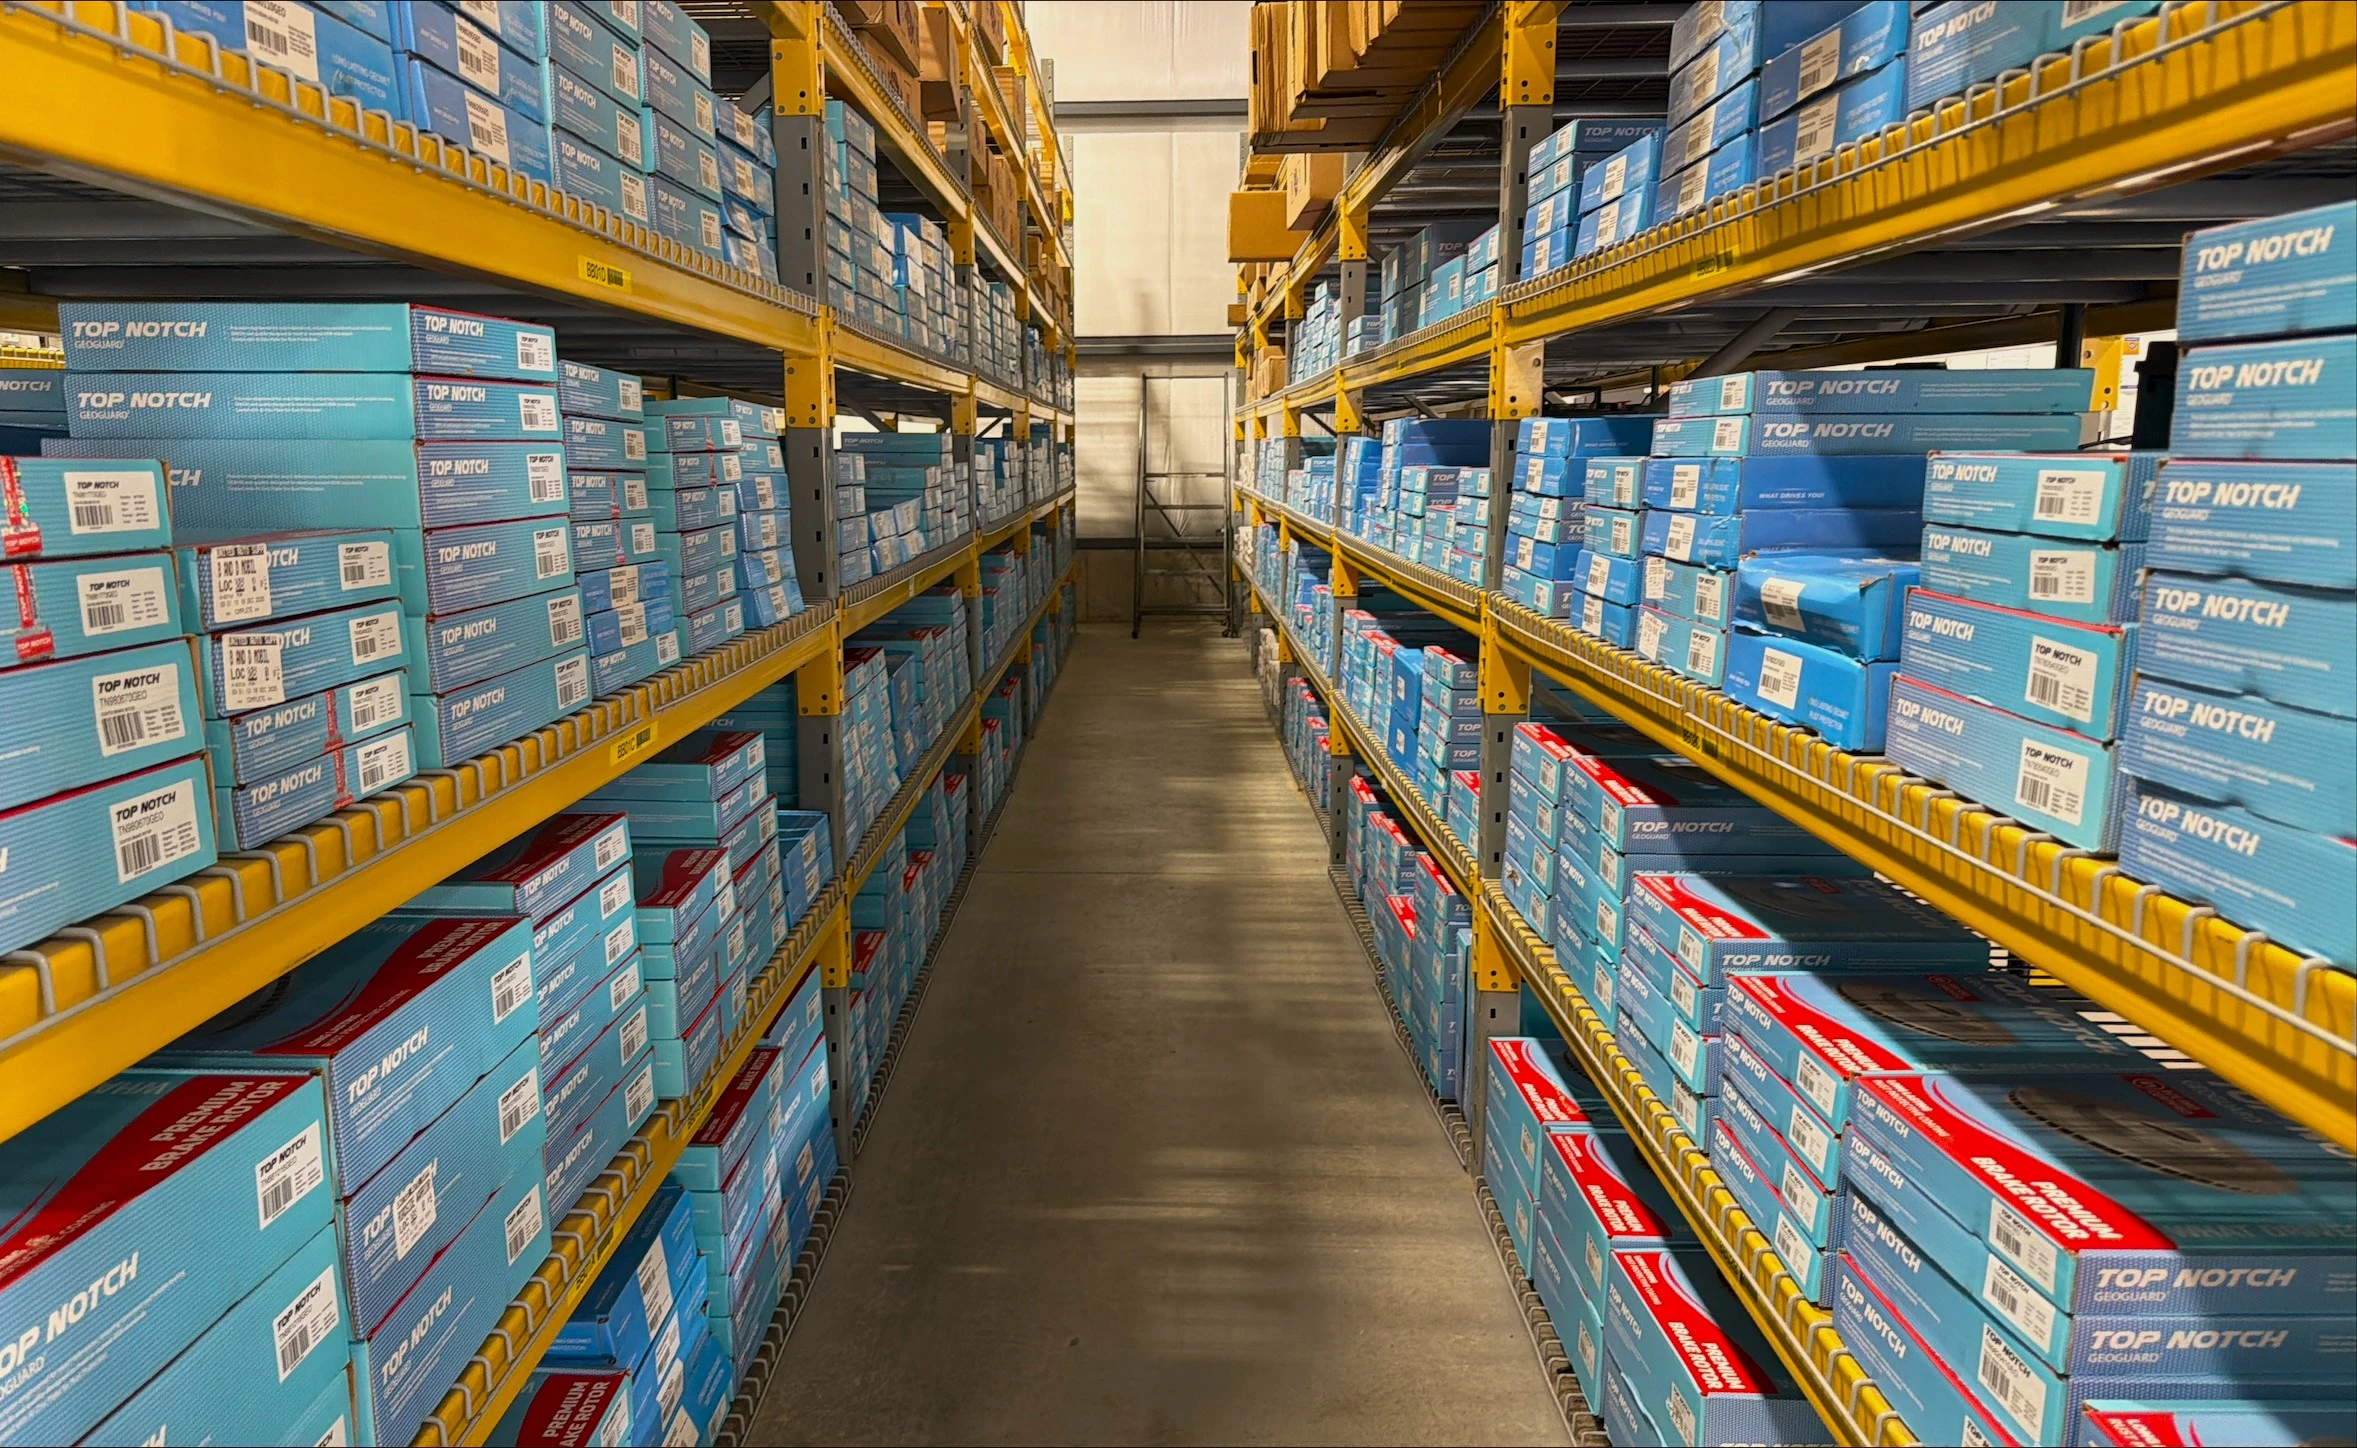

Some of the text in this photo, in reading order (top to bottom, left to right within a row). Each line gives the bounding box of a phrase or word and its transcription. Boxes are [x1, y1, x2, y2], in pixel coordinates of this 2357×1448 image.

[554, 4, 592, 42] TOP NOTCH
[1917, 2, 1995, 51] TOP NOTCH
[559, 75, 573, 91] TOP
[574, 84, 596, 109] NOTCH
[560, 141, 600, 172] TOP NOTCH
[2196, 225, 2334, 273] TOP NOTCH
[72, 322, 207, 338] TOP NOTCH
[425, 315, 483, 337] TOP NOTCH
[74, 340, 124, 349] GEOGUARD
[0, 380, 51, 392] NOTCH
[1766, 379, 1901, 395] TOP NOTCH
[2189, 358, 2324, 390] TOP NOTCH
[78, 392, 212, 408] TOP NOTCH
[428, 384, 485, 402] TOP NOTCH
[1766, 397, 1815, 405] GEOGUARD
[79, 410, 129, 420] GEOGUARD
[1762, 423, 1894, 438] TOP NOTCH
[1762, 440, 1809, 448] GEOGUARD
[430, 460, 489, 476] TOP NOTCH
[1433, 473, 1456, 481] TOP
[1932, 464, 1998, 483] TOP NOTCH
[2165, 481, 2301, 510] TOP NOTCH
[439, 541, 496, 564] TOP NOTCH
[1928, 534, 1992, 557] TOP NOTCH
[219, 580, 233, 592] LOC
[2155, 588, 2290, 628] TOP NOTCH
[441, 618, 496, 645] TOP NOTCH
[1909, 611, 1975, 642] TOP NOTCH
[2035, 643, 2082, 666] TOP NOTCH
[98, 673, 160, 694] TOP NOTCH
[231, 668, 245, 680] LOC
[246, 702, 316, 738] TOP NOTCH
[451, 687, 505, 720] TOP NOTCH
[1896, 698, 1964, 736] TOP NOTCH
[2144, 692, 2276, 744] TOP NOTCH
[2025, 746, 2073, 769] TOP NOTCH
[251, 765, 322, 805] TOP NOTCH
[116, 791, 176, 823] TOP NOTCH
[1633, 822, 1734, 833] TOP NOTCH
[2138, 795, 2260, 856] TOP NOTCH
[524, 857, 570, 897] TOP NOTCH
[416, 922, 482, 960] PREMIUM
[418, 922, 506, 974] BRAKE ROTOR
[1721, 954, 1831, 966] TOP NOTCH
[1727, 984, 1772, 1031] TOP NOTCH
[554, 1011, 580, 1041] NOTCH
[348, 1025, 429, 1104] TOP NOTCH
[1724, 1032, 1767, 1082] TOP NOTCH
[1795, 1024, 1862, 1072] BRAKE ROTOR
[1832, 1038, 1887, 1072] PREMIUM
[149, 1081, 255, 1142] PREMIUM
[1723, 1082, 1762, 1134] TOP NOTCH
[1857, 1088, 1909, 1139] TOP NOTCH
[139, 1081, 289, 1172] BRAKE ROTOR
[259, 1135, 307, 1178] TOP NOTCH
[1714, 1129, 1756, 1183] TOP NOTCH
[1851, 1136, 1905, 1190] TOP NOTCH
[1587, 1185, 1627, 1233] BRAKE ROTOR
[1970, 1156, 2091, 1241] BRAKE ROTOR
[2029, 1181, 2124, 1241] PREMIUM
[363, 1205, 392, 1248] TOP
[1612, 1200, 1646, 1233] PREMIUM
[1851, 1198, 1922, 1273] TOP NOTCH
[2096, 1269, 2297, 1288] TOP NOTCH
[277, 1282, 321, 1331] TOP NOTCH
[2094, 1291, 2167, 1301] GEOGUARD
[0, 1326, 39, 1379] OP
[46, 1250, 139, 1344] NOTCH
[1839, 1276, 1906, 1359] TOP NOTCH
[382, 1339, 409, 1386] TOP
[411, 1285, 452, 1351] NOTCH
[2090, 1330, 2289, 1349] TOP NOTCH
[1668, 1321, 1724, 1390] BRAKE ROTOR
[1701, 1342, 1745, 1390] PREMIUM
[1985, 1328, 2031, 1378] TOP NOTCH
[2088, 1353, 2160, 1363] GEOGUARD
[542, 1381, 589, 1438] PREMIUM
[559, 1381, 610, 1446] AKE ROTOR
[2126, 1419, 2161, 1444] LONG
